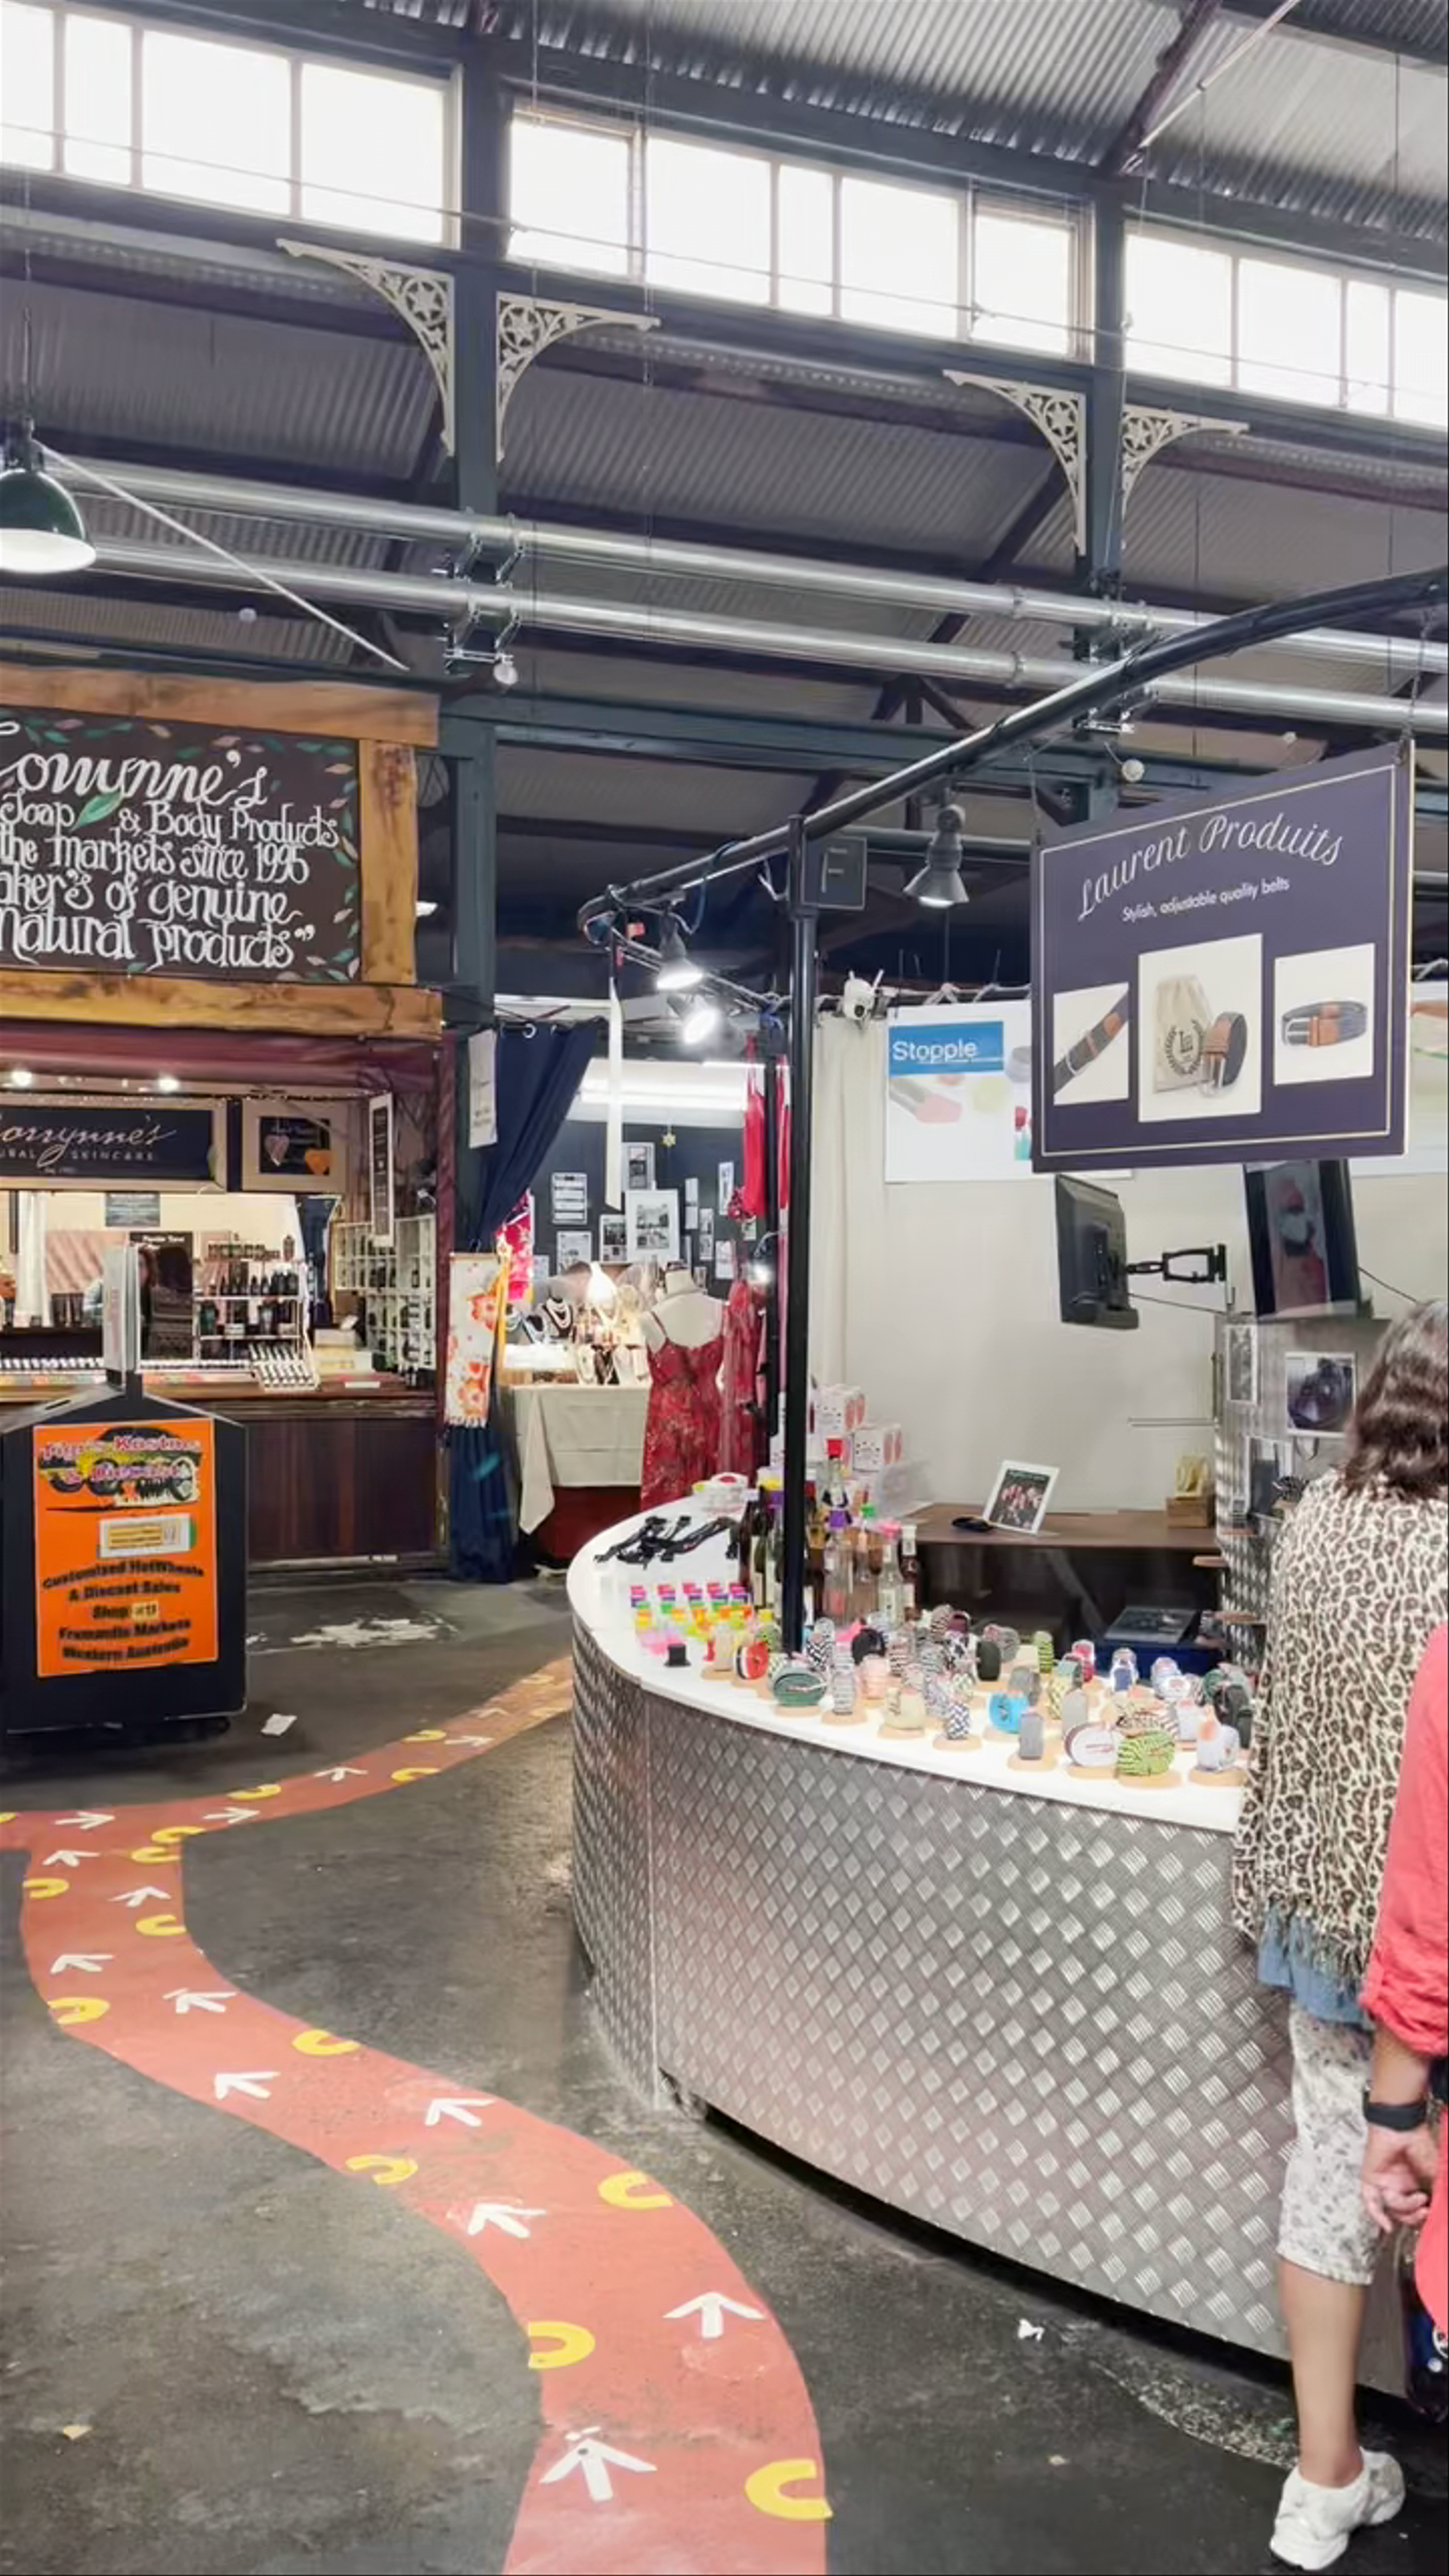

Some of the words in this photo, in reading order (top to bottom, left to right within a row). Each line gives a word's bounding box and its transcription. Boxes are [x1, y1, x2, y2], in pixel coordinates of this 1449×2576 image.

[0, 721, 268, 808] orrynne's
[0, 787, 75, 838] Soap
[118, 807, 142, 837] &
[143, 798, 223, 847] Body
[229, 802, 339, 847] Products
[180, 840, 248, 884] since
[252, 841, 309, 884] 1995
[821, 847, 848, 893] F
[1078, 826, 1189, 922] Laurent
[1198, 812, 1343, 865] Produits
[105, 871, 138, 918] of
[137, 880, 303, 927] genuine
[1121, 902, 1157, 923] Stylish,
[1160, 890, 1217, 914] adjustable
[1219, 882, 1259, 906] quality
[1261, 876, 1290, 895] belts
[892, 1038, 978, 1064] Stopple
[0, 1113, 177, 1167] orrynne's
[72, 1150, 154, 1161] SKINCARE
